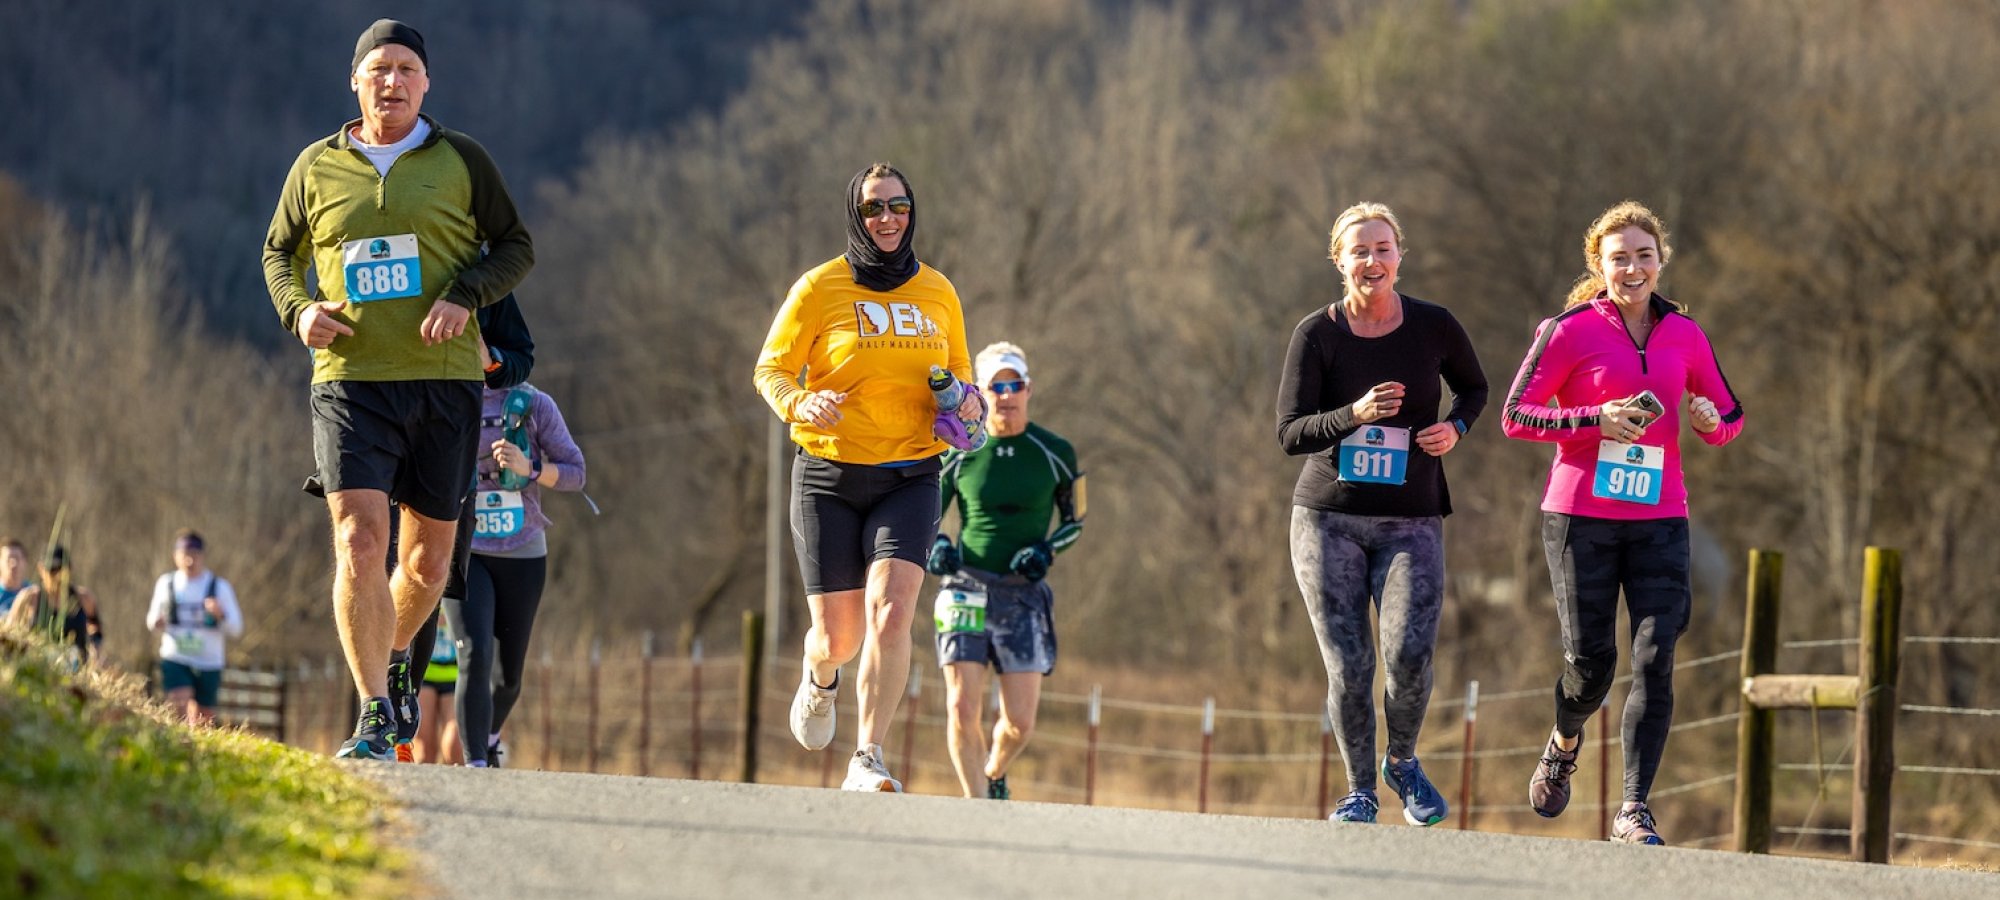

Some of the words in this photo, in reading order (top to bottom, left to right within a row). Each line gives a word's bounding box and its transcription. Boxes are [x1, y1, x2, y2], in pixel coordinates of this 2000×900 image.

[356, 263, 409, 296] 888
[857, 341, 886, 350] HALF
[889, 341, 944, 351] MARATHON
[1352, 450, 1393, 478] 911
[1607, 467, 1652, 498] 910
[475, 510, 515, 534] 853
